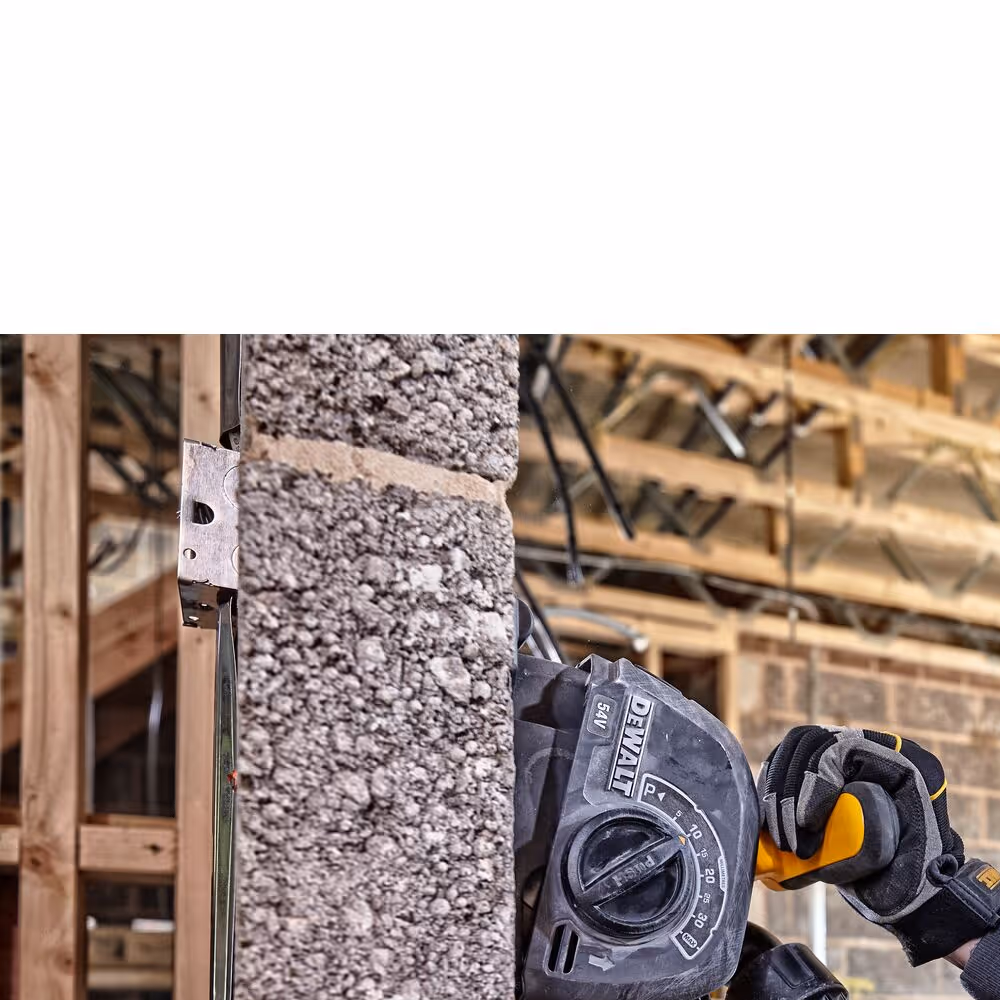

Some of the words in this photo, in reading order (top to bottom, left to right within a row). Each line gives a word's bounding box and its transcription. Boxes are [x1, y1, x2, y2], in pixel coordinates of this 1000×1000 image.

[594, 702, 610, 730] 54V
[611, 695, 652, 798] DEWALT
[643, 782, 656, 796] P
[675, 810, 683, 818] 5
[689, 824, 703, 840] 10
[700, 847, 709, 858] 15
[704, 868, 716, 884] 20
[702, 892, 711, 904] 25
[694, 912, 708, 929] 30
[683, 933, 697, 947] MAX
